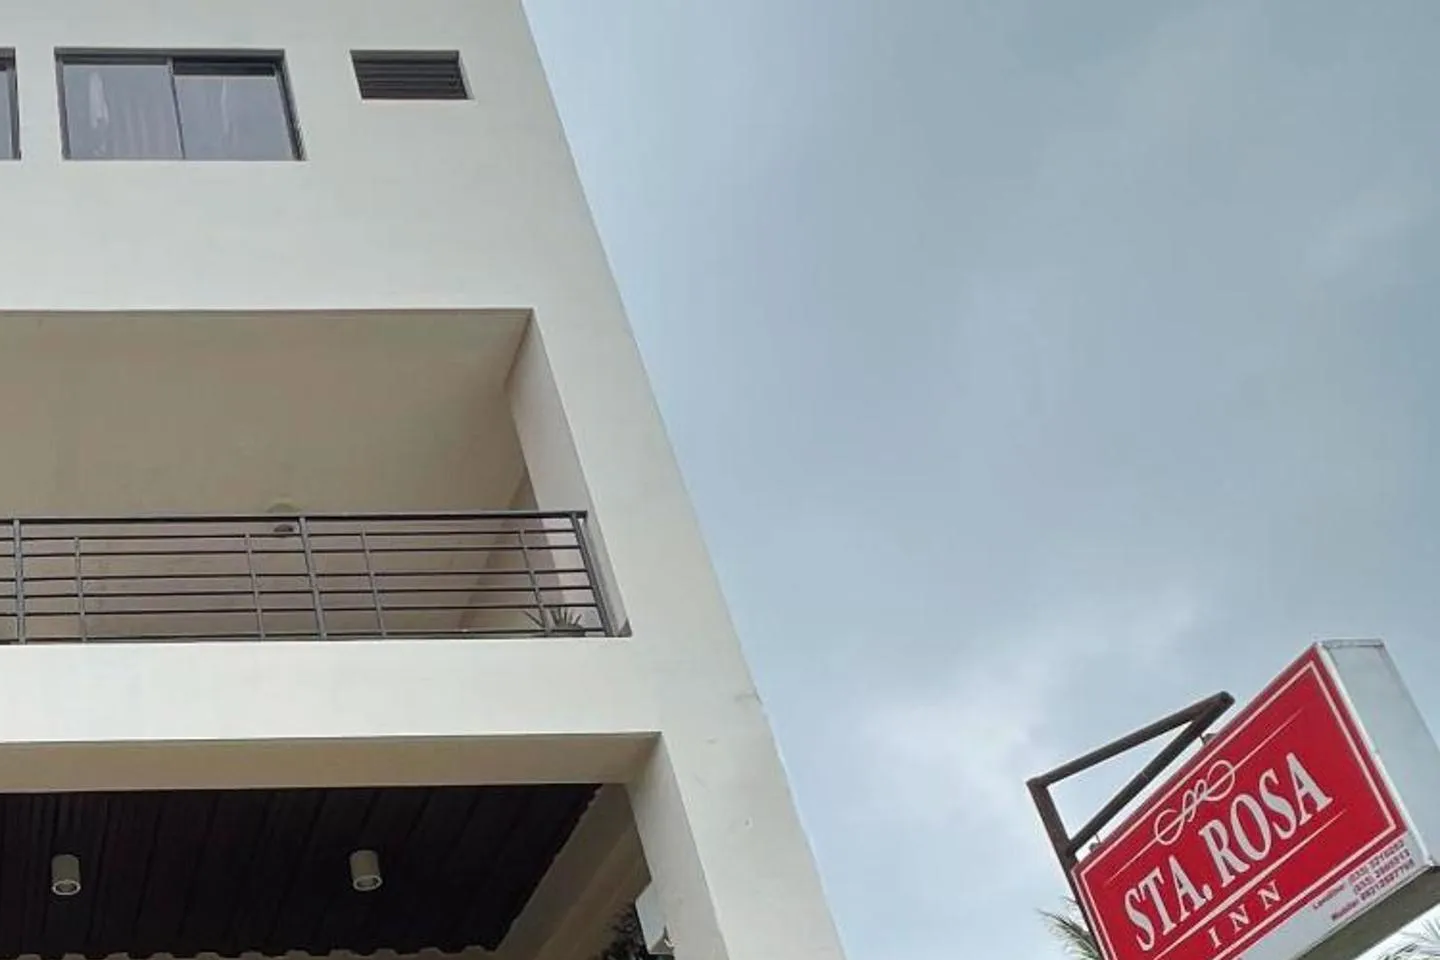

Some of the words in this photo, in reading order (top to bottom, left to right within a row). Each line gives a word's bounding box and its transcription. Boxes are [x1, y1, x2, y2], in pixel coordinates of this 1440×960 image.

[1124, 854, 1213, 951] STA.
[1198, 752, 1333, 888] ROSA
[1208, 879, 1281, 949] INN
